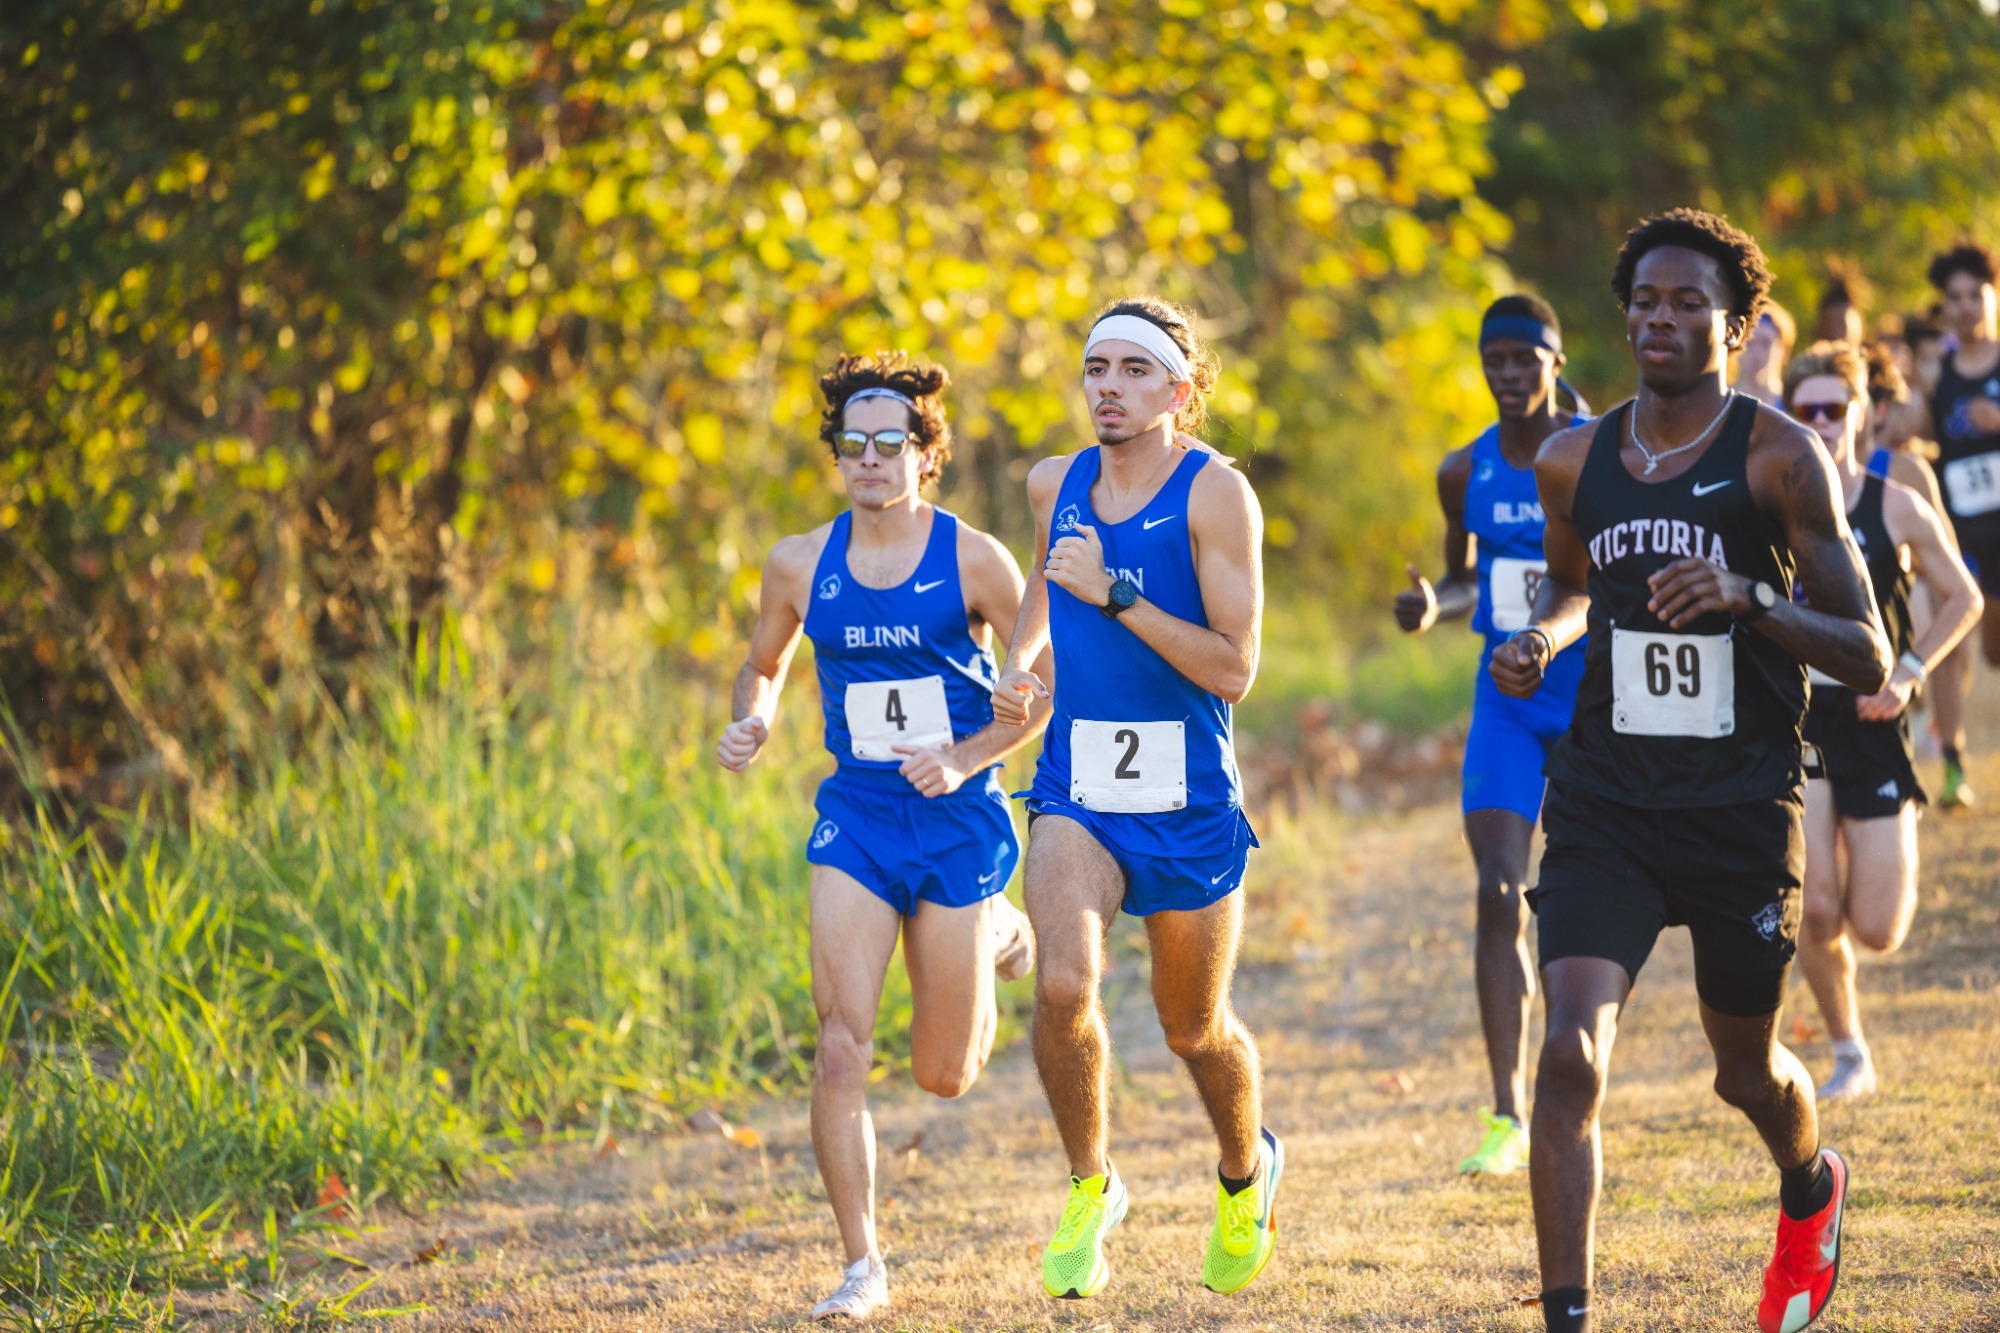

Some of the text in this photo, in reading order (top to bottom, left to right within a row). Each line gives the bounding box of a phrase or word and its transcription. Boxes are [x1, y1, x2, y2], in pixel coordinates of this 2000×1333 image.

[1589, 518, 1728, 571] VICTORIA
[844, 625, 921, 649] BLINN
[1645, 642, 1700, 698] 69
[885, 688, 908, 731] 4
[1114, 729, 1140, 779] 2
